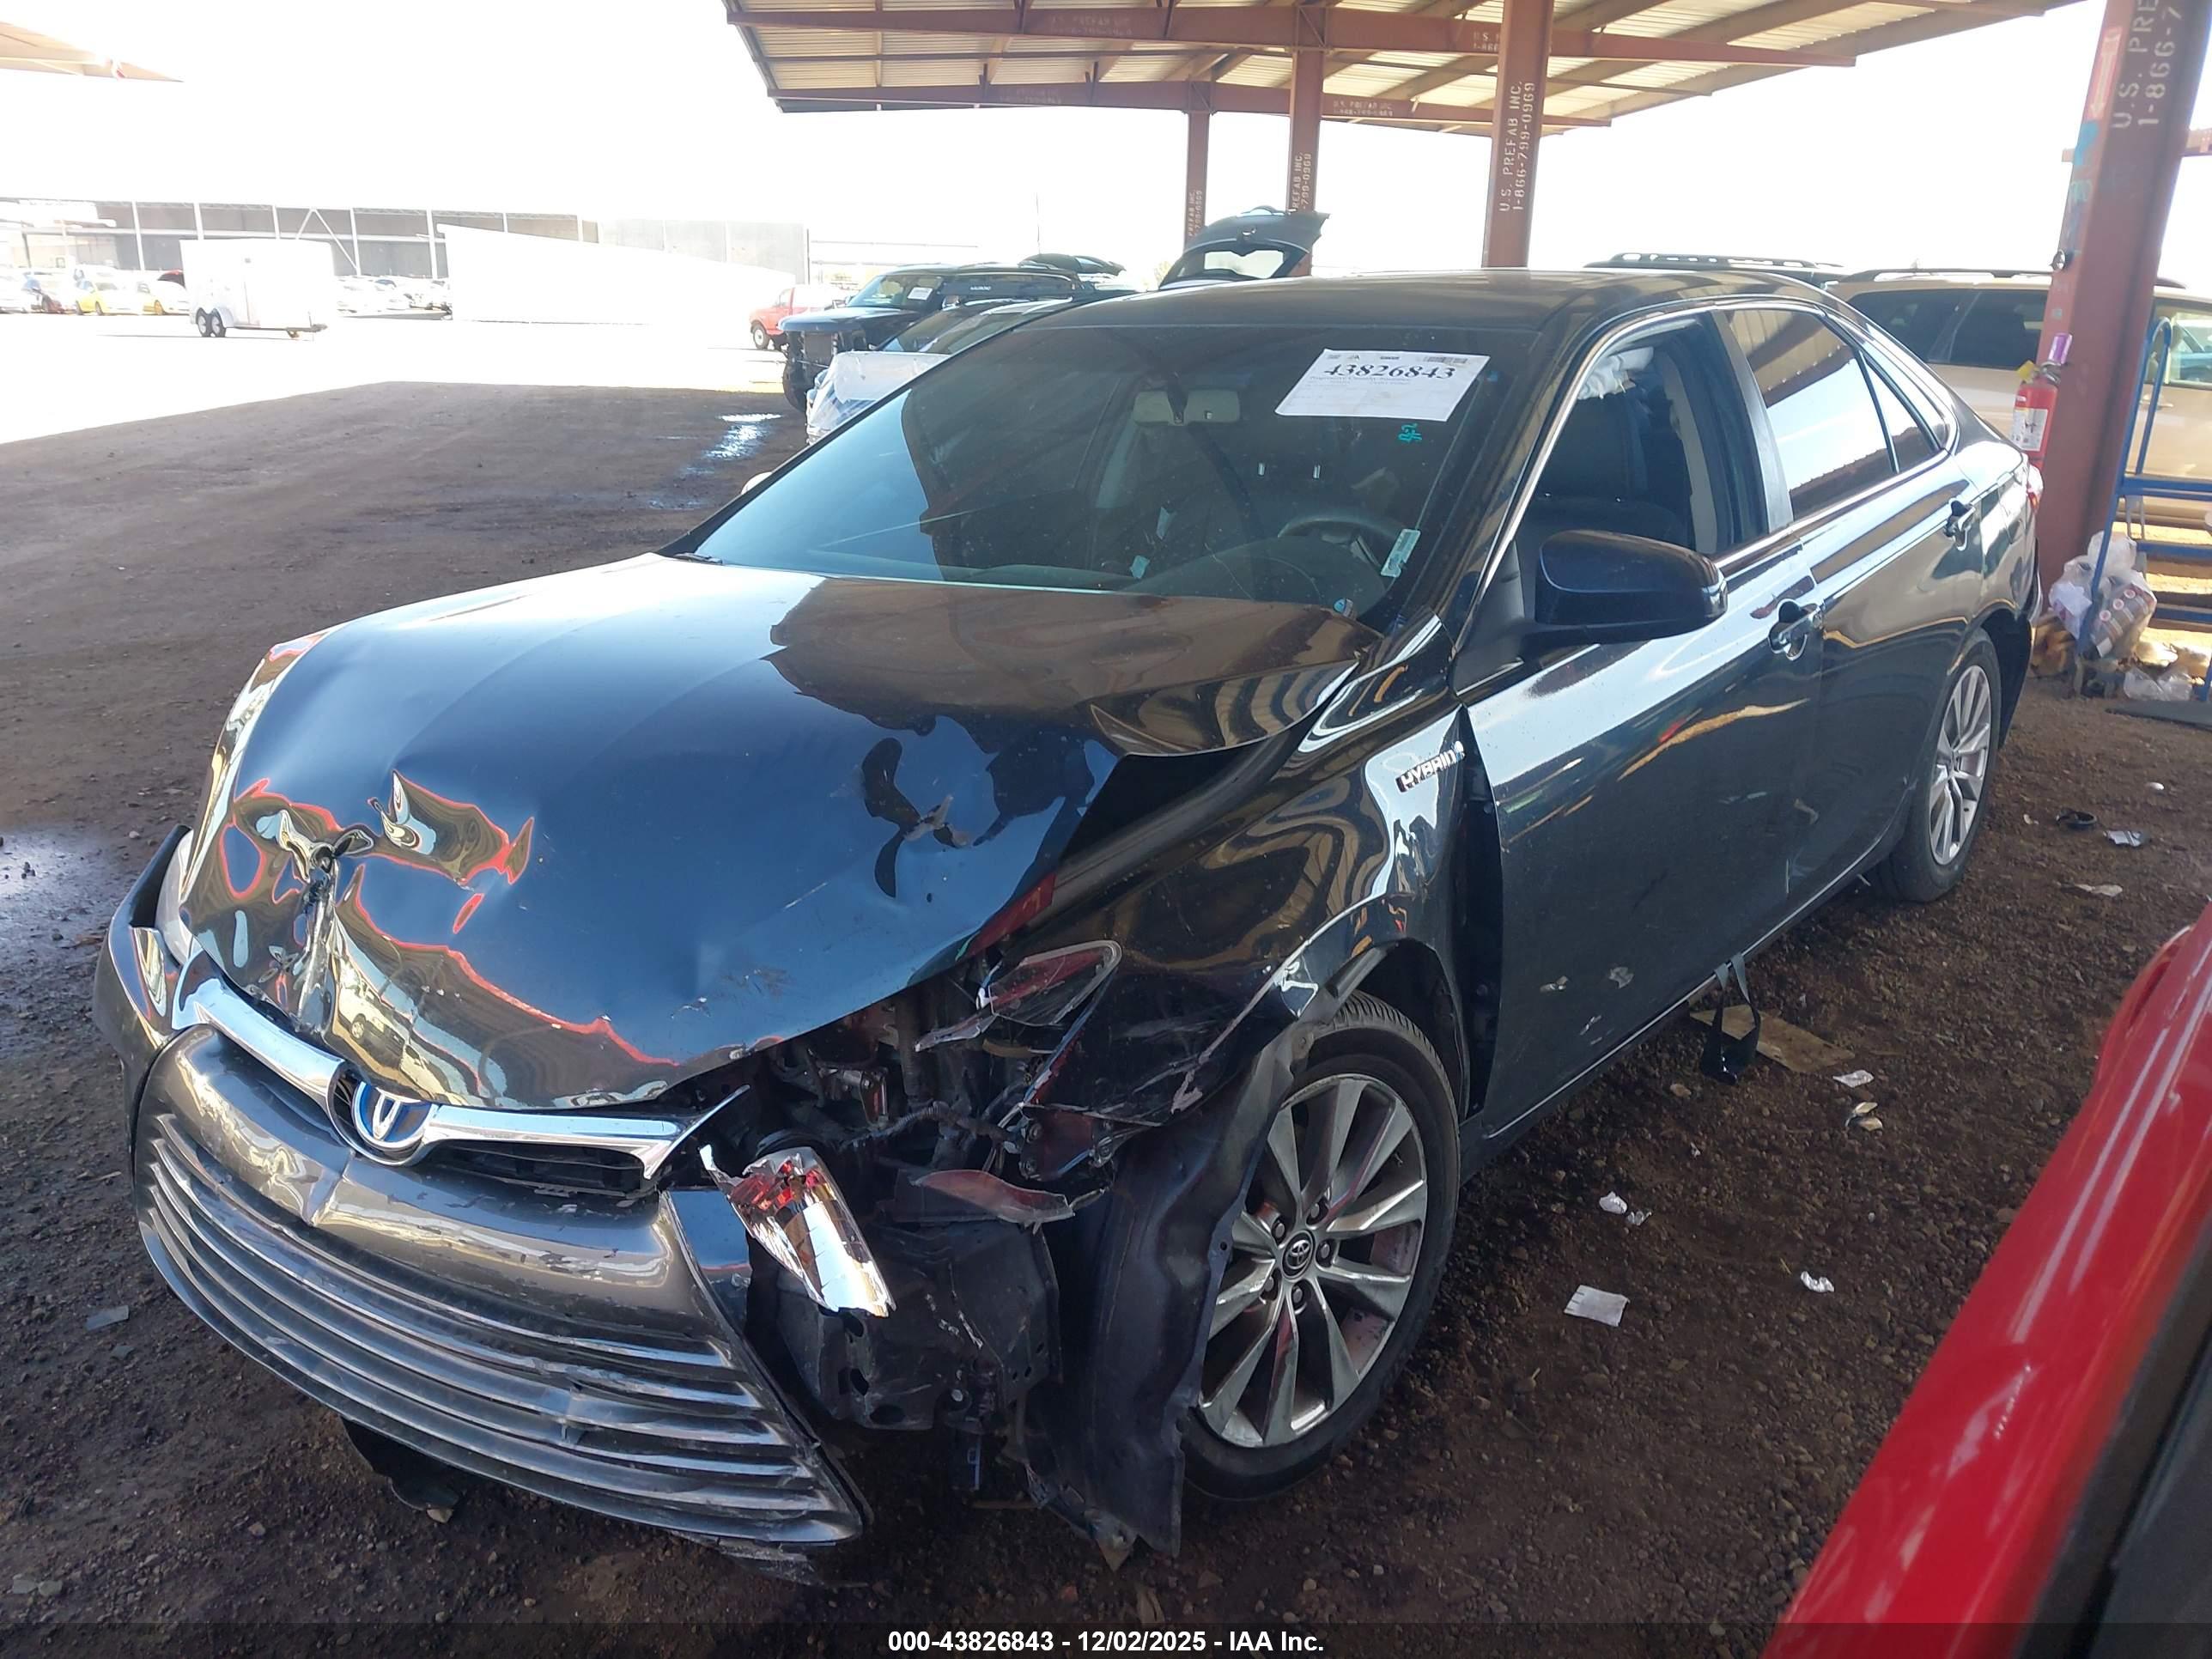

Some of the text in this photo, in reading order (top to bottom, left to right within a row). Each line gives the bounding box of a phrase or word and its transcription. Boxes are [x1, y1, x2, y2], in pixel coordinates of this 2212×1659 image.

[2112, 72, 2143, 129] U.S.
[1502, 117, 1519, 175] PREFAB
[1512, 82, 1534, 210] 1-866-799-0969
[1499, 184, 1513, 212] U.S.
[1323, 363, 1456, 380] 43826843
[1400, 749, 1457, 790] HYBRID
